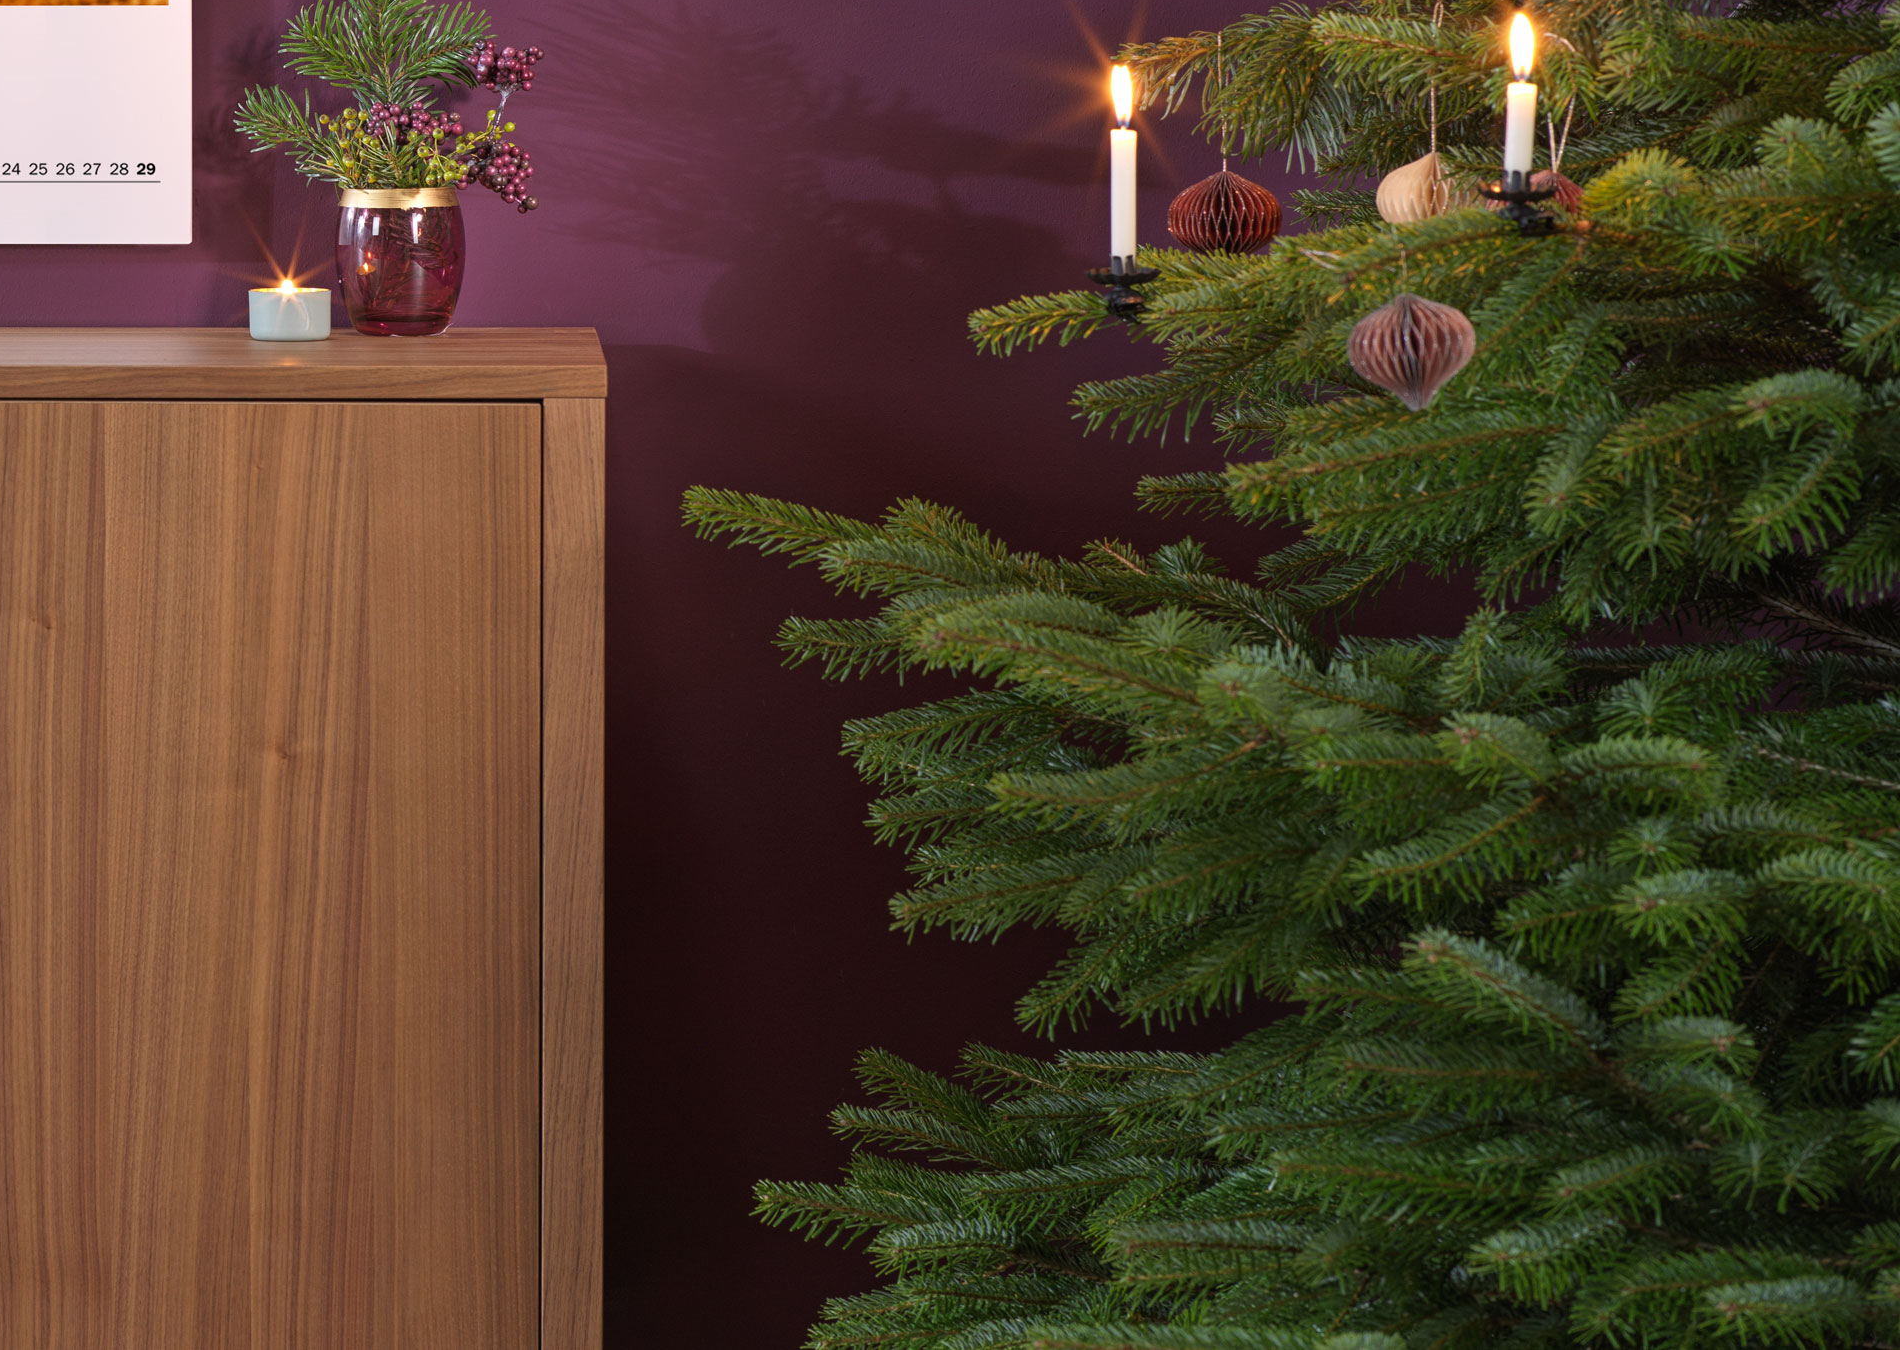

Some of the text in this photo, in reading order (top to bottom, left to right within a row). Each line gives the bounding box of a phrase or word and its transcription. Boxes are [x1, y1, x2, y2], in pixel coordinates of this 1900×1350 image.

[1, 162, 22, 176] 24
[28, 162, 49, 176] 25
[55, 162, 76, 177] 26
[82, 162, 102, 176] 27
[109, 162, 130, 176] 28
[136, 162, 157, 176] 29
